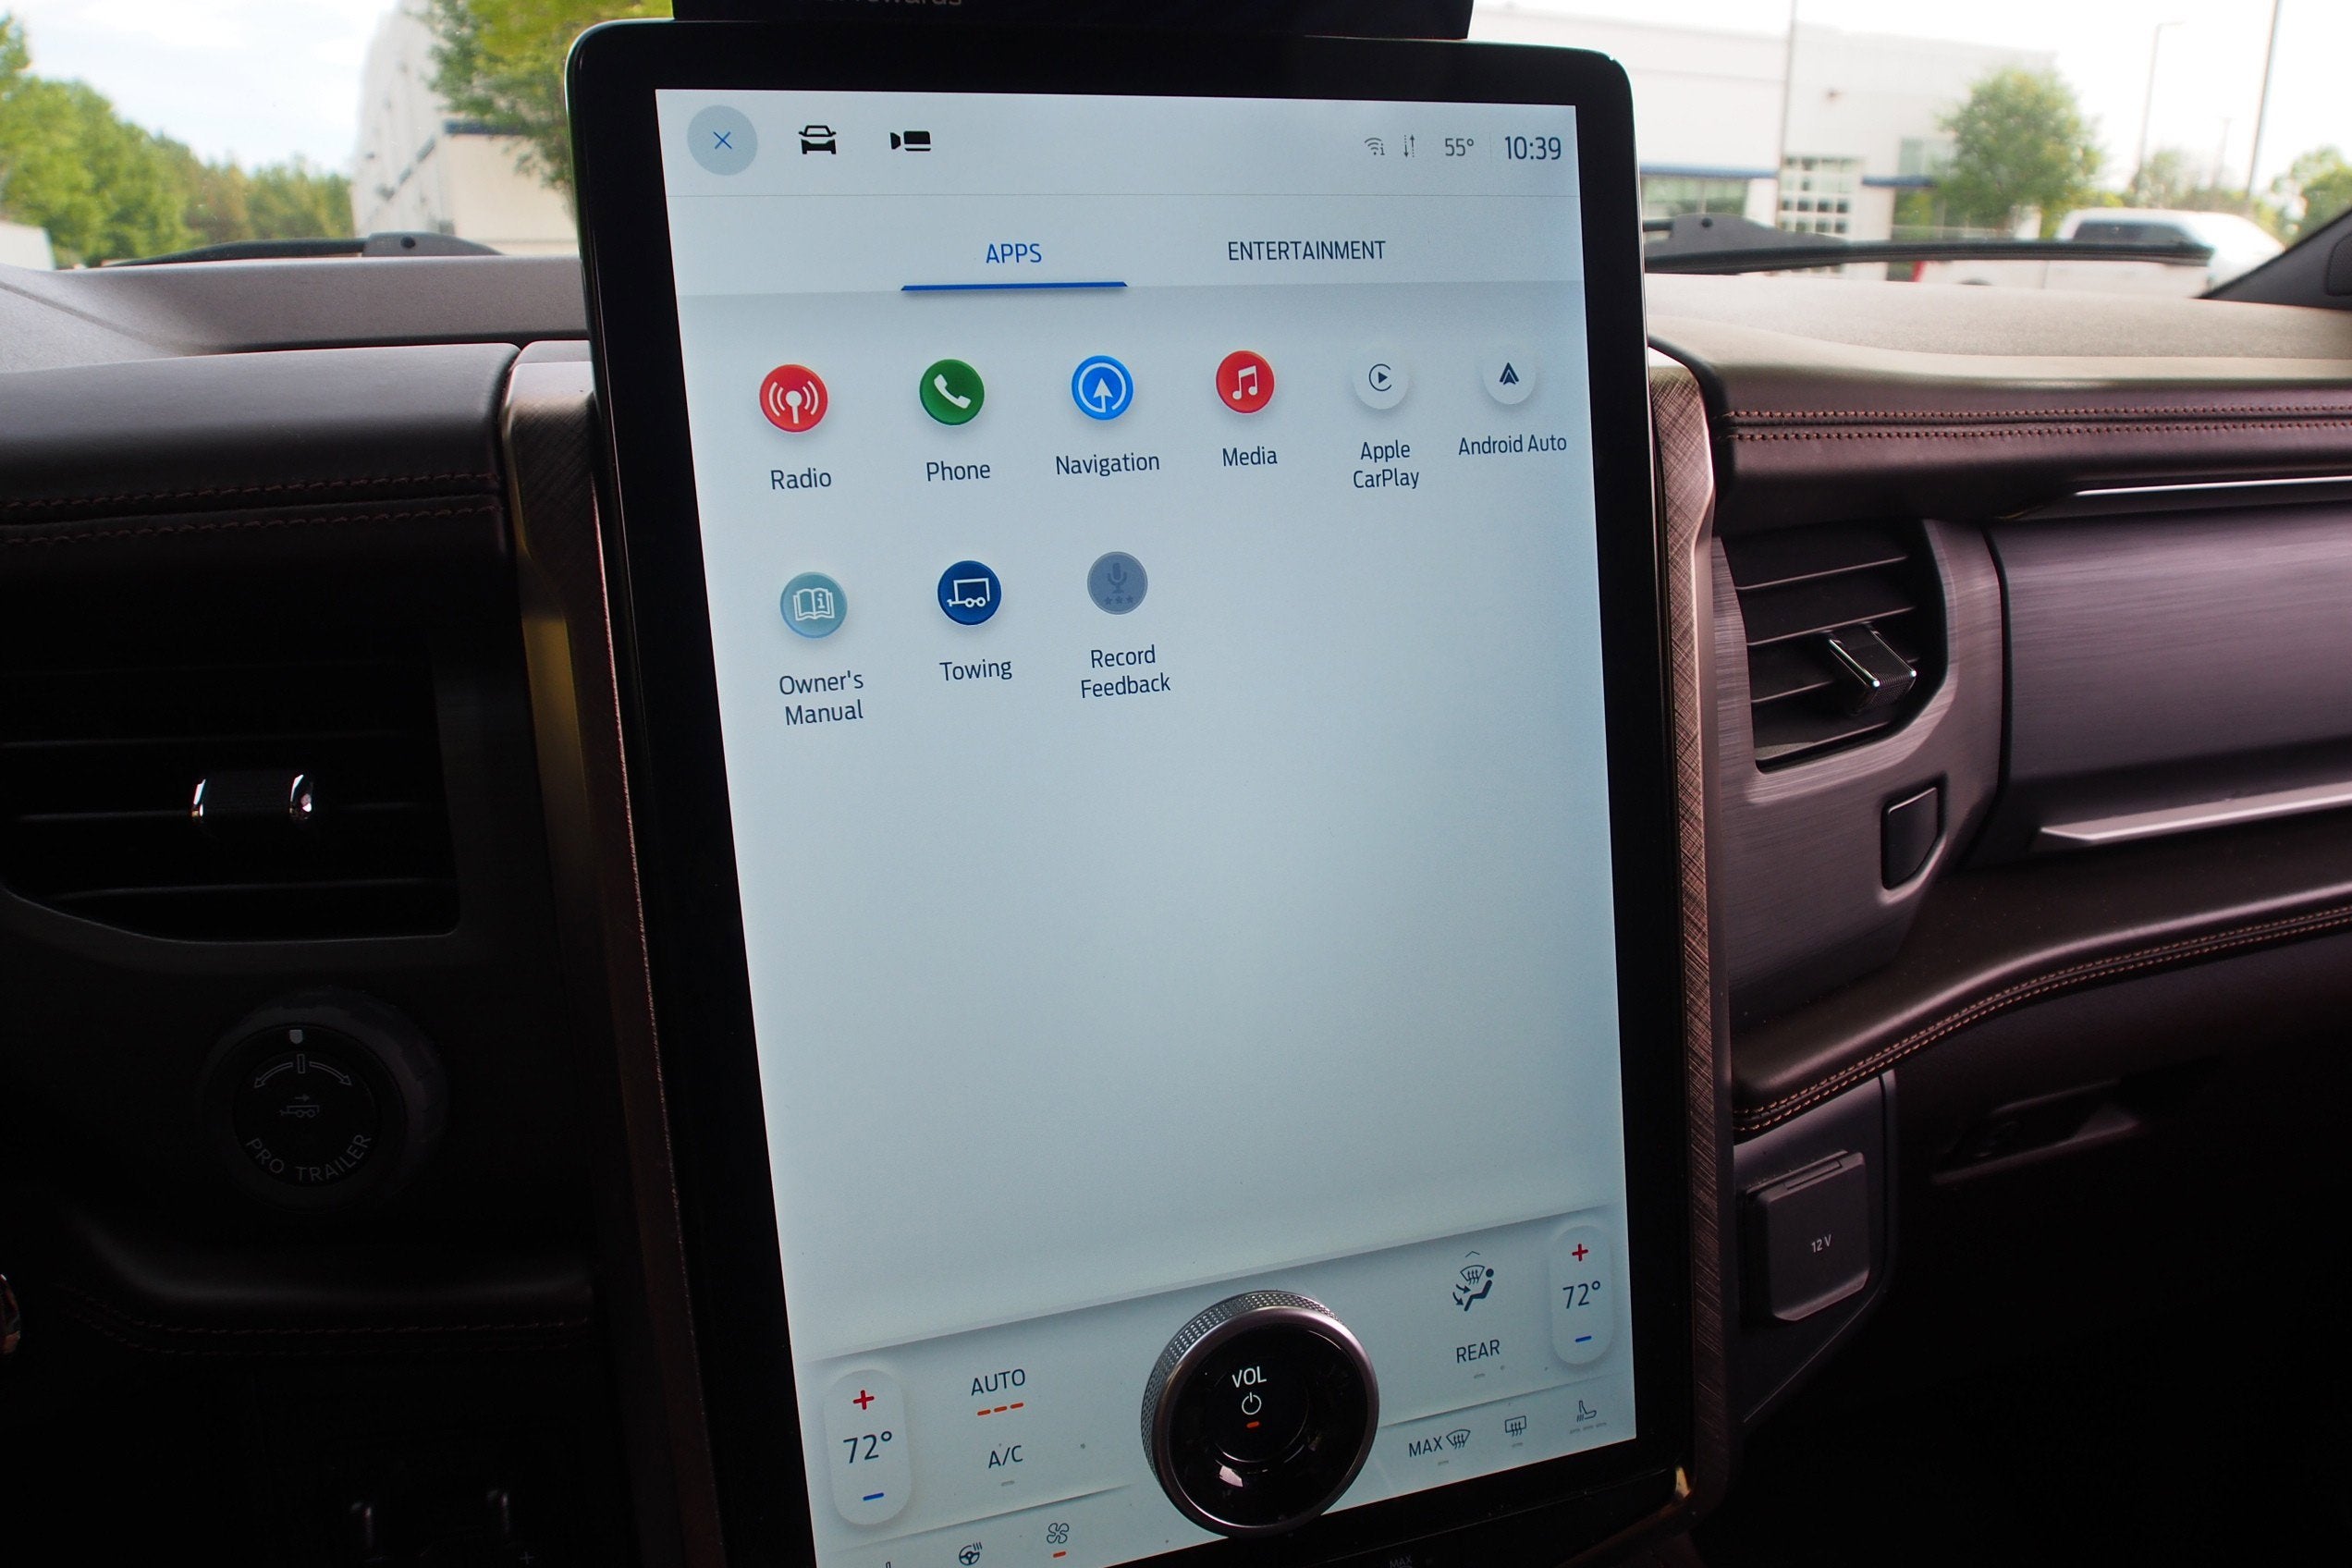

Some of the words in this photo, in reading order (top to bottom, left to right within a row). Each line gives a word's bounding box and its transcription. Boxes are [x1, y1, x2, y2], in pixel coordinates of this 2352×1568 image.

[1444, 138, 1475, 157] 55°
[1504, 136, 1562, 161] 10:39
[986, 242, 1042, 264] APPS
[1228, 240, 1387, 262] ENTERTAINMENT
[1222, 446, 1279, 467] Media
[1360, 439, 1411, 463] Apple
[1458, 434, 1524, 456] Android
[1527, 434, 1567, 453] Auto
[925, 460, 991, 483] Phone
[1055, 452, 1160, 477] Navigation
[770, 467, 832, 490] Radio
[1353, 467, 1420, 490] CarPlay
[1090, 644, 1156, 669] Record
[778, 669, 864, 695] Owner's
[939, 657, 1013, 682] Towing
[1081, 672, 1171, 699] Feedback
[785, 699, 864, 726] Manual
[245, 1137, 285, 1174] PRO
[295, 1133, 372, 1183] TRAILER
[1811, 1238, 1823, 1253] 12
[1562, 1280, 1601, 1310] 72°
[1456, 1339, 1501, 1364] REAR
[972, 1369, 1026, 1397] AUTO
[1231, 1366, 1268, 1389] VOL
[842, 1430, 893, 1464] 72°
[987, 1444, 1023, 1469] A/C
[1408, 1435, 1443, 1458] MAX
